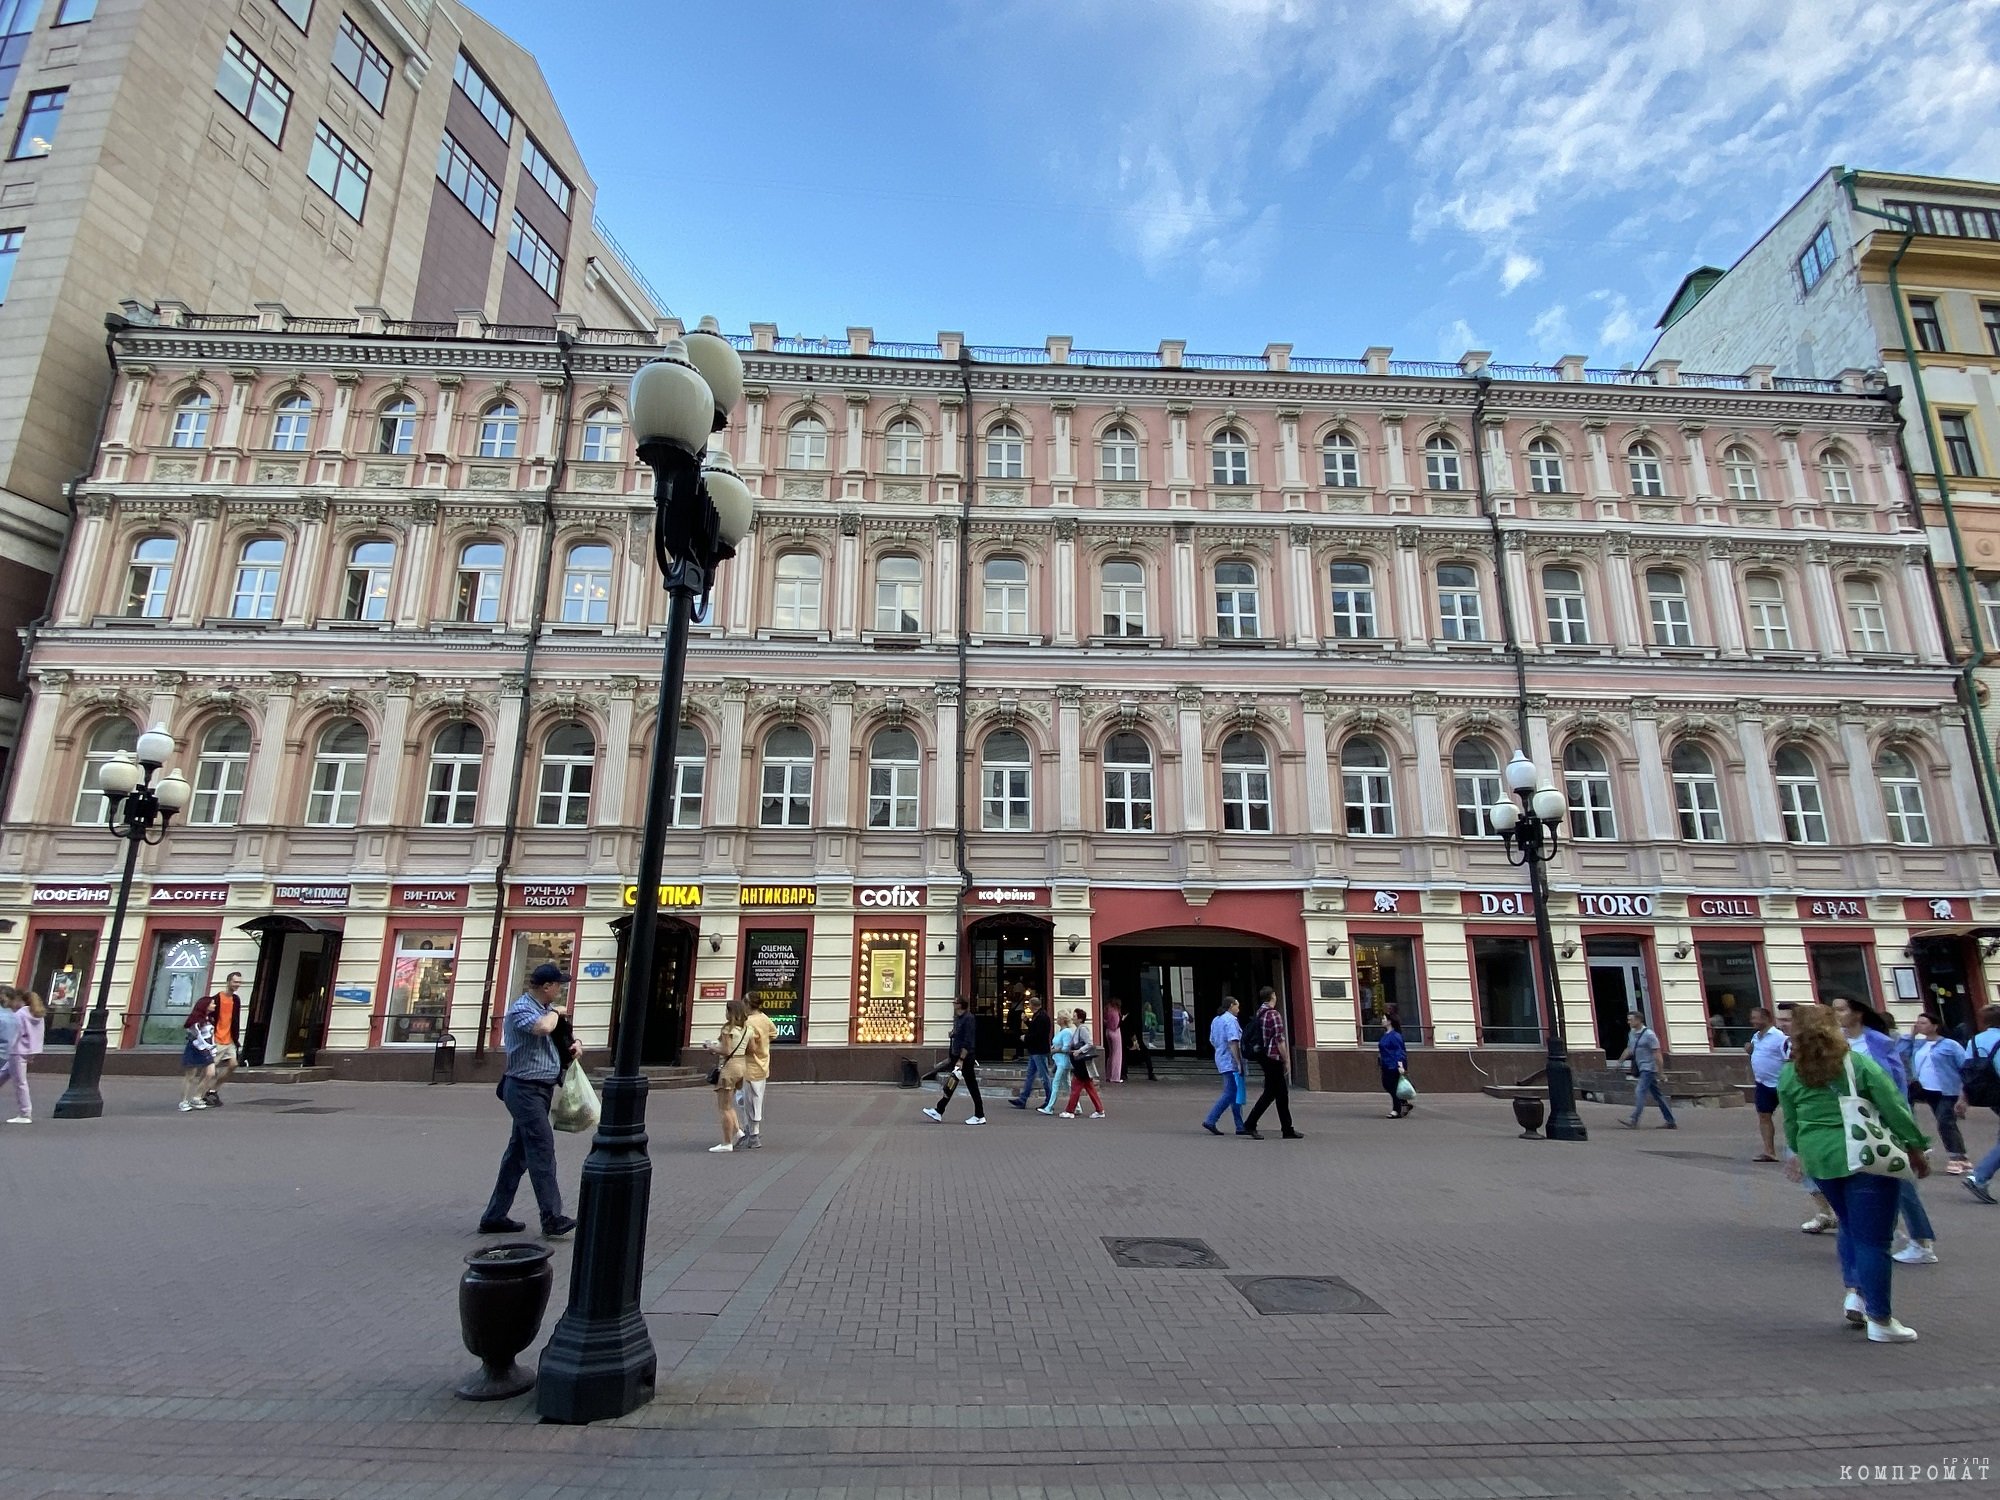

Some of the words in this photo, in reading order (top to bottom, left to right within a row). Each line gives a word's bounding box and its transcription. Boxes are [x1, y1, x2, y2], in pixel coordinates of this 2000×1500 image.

[33, 888, 110, 901] КОФЕЙНЯ
[173, 890, 226, 900] COFFEE
[276, 886, 300, 898] ТВОЯ
[314, 887, 348, 899] ПОЛКА
[403, 890, 457, 901] ВИНТАЖ
[523, 886, 575, 896] РУЧНАЯ
[624, 886, 701, 905] СПКА
[740, 887, 815, 905] АНТИКВАРЪ
[860, 885, 920, 906] cofix
[979, 888, 1035, 903] кофейня
[525, 896, 569, 906] РАБОТА
[1480, 893, 1525, 914] Del
[1580, 894, 1653, 916] TORO
[1701, 900, 1754, 915] GRILL
[758, 991, 798, 1000] ОКУПКА
[758, 1000, 793, 1009] ОНЕТ
